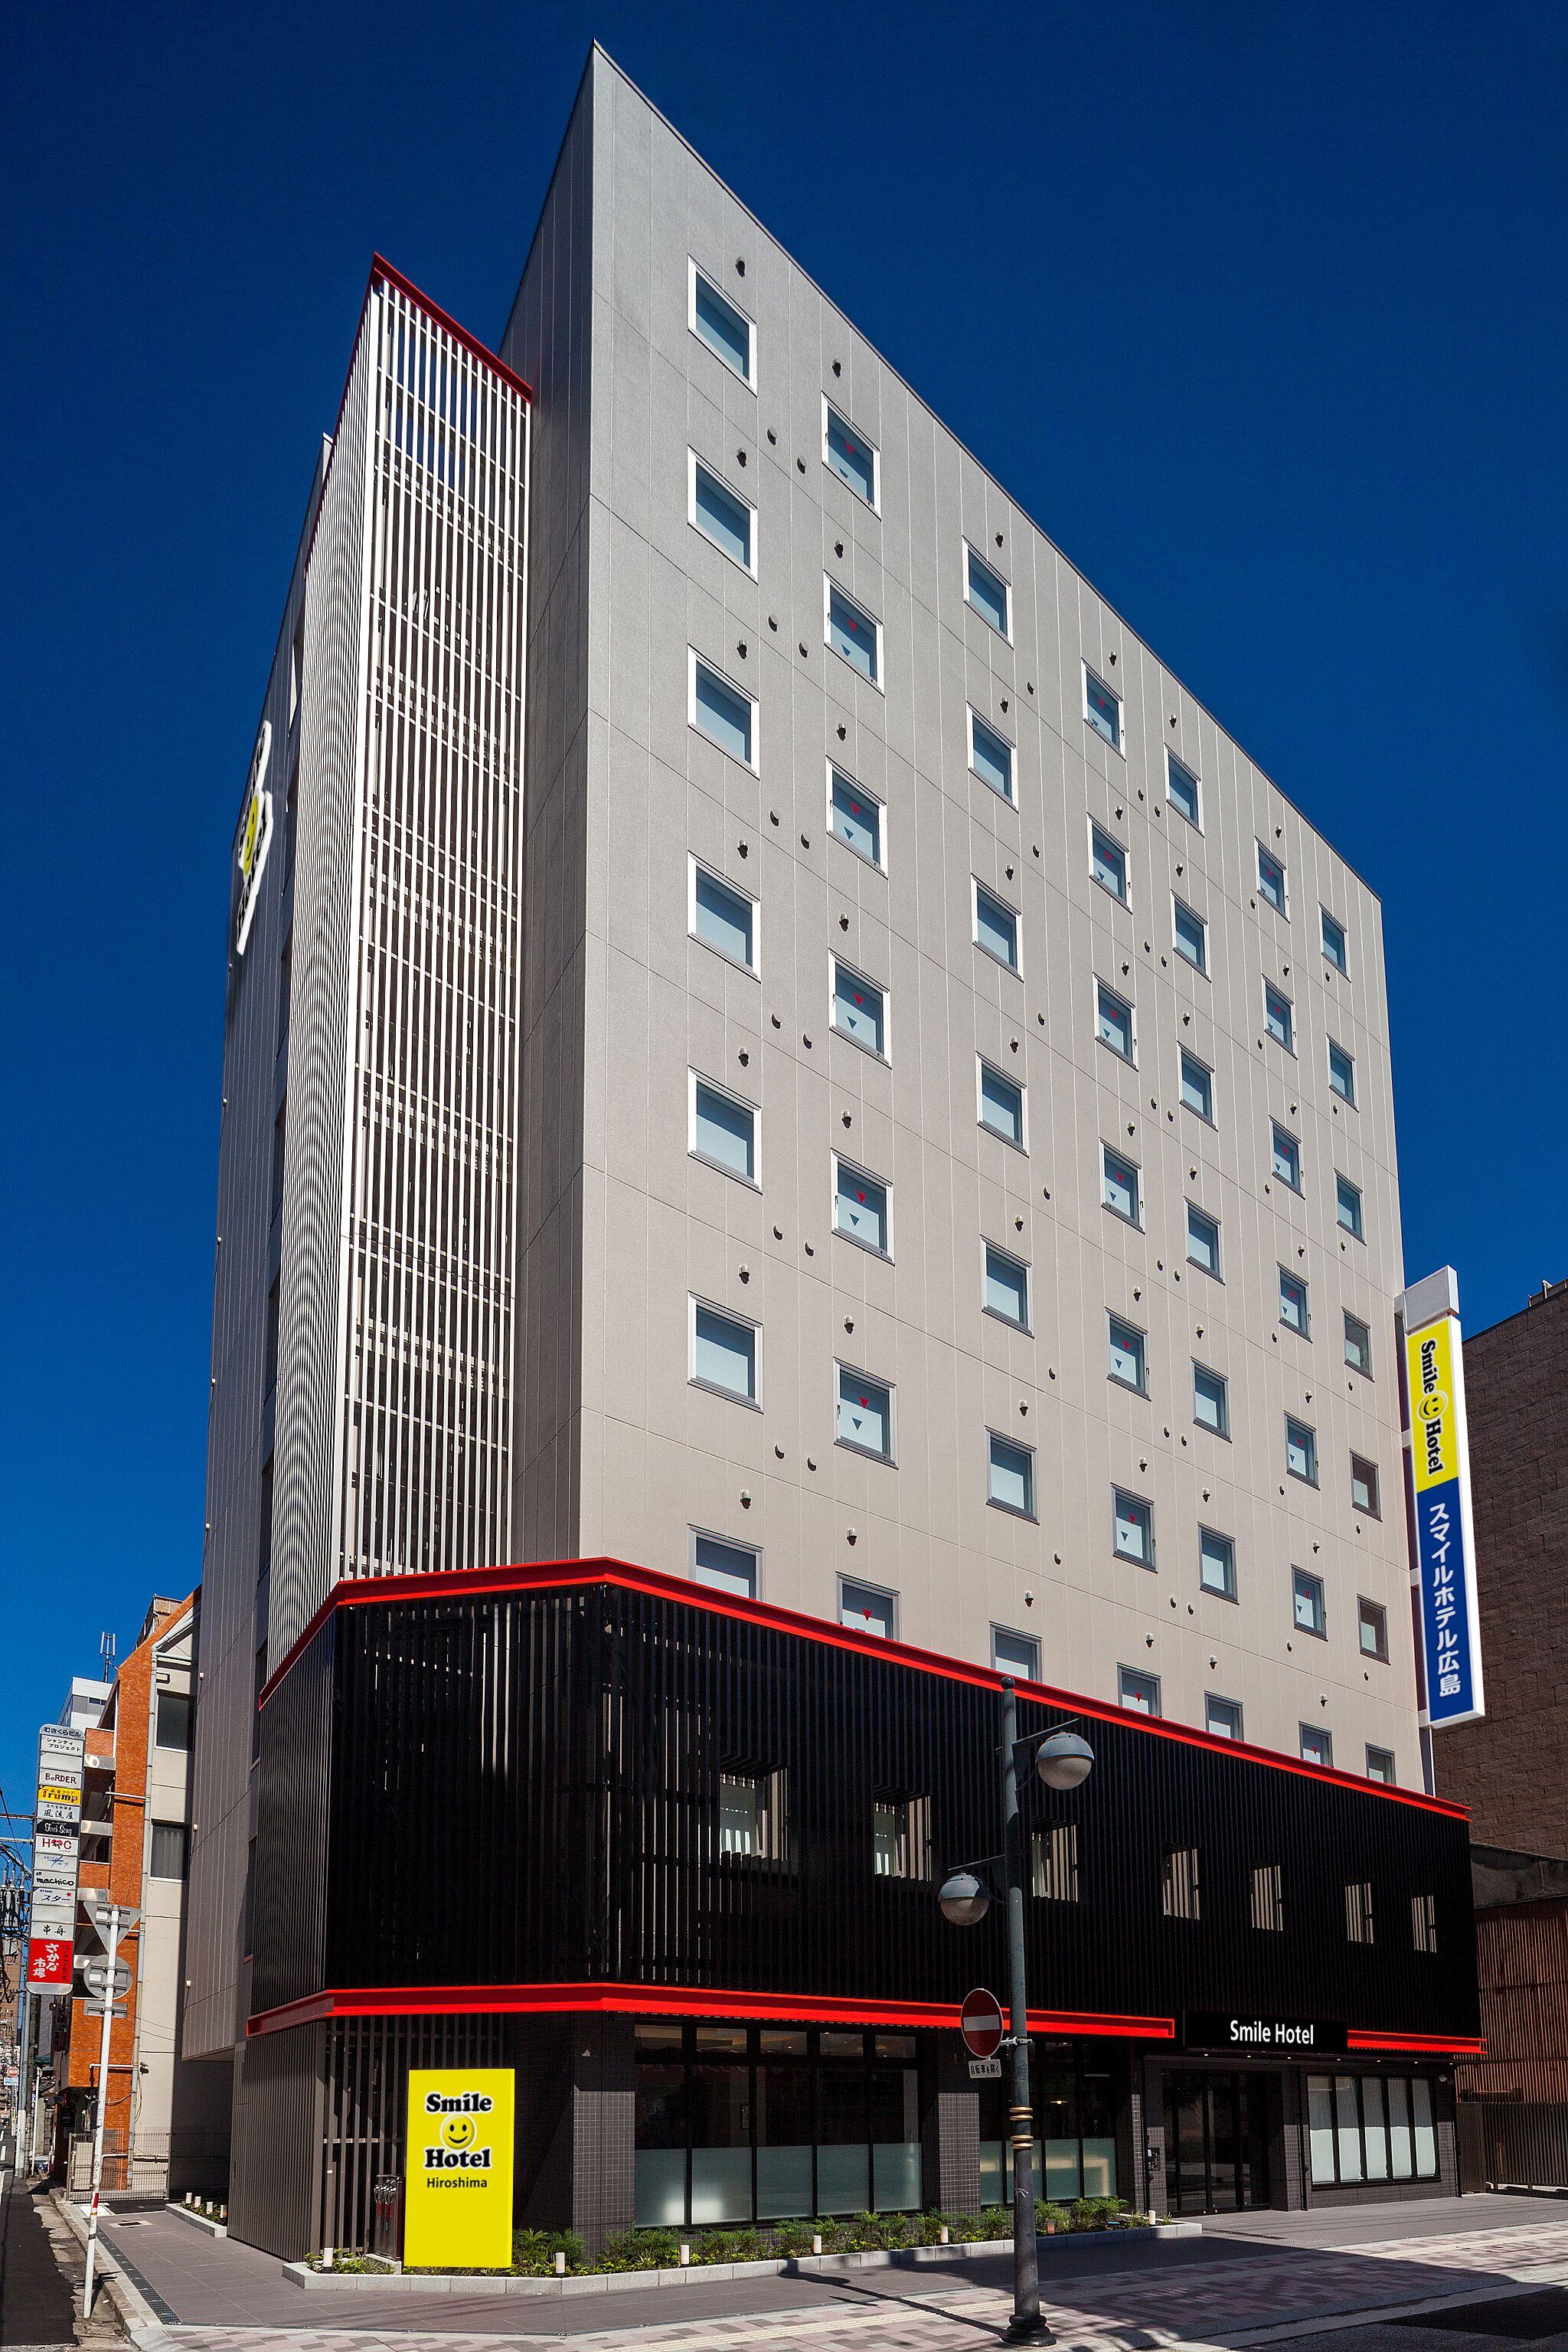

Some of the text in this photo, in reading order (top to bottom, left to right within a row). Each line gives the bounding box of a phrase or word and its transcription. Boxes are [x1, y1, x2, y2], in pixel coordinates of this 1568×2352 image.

[1421, 1340, 1444, 1475] Smile Hotel
[1429, 1502, 1461, 1697] スマイルホテル広島
[49, 1743, 81, 1752] プロジェクト
[42, 1788, 78, 1803] Trump
[37, 1877, 75, 1886] machico
[45, 1942, 60, 1971] さかな
[32, 1957, 46, 1978] 市場
[1230, 2019, 1314, 2045] Smile Hotel
[426, 2092, 492, 2112] Smile
[425, 2148, 491, 2168] Hotel
[426, 2177, 488, 2188] Hiroshima
